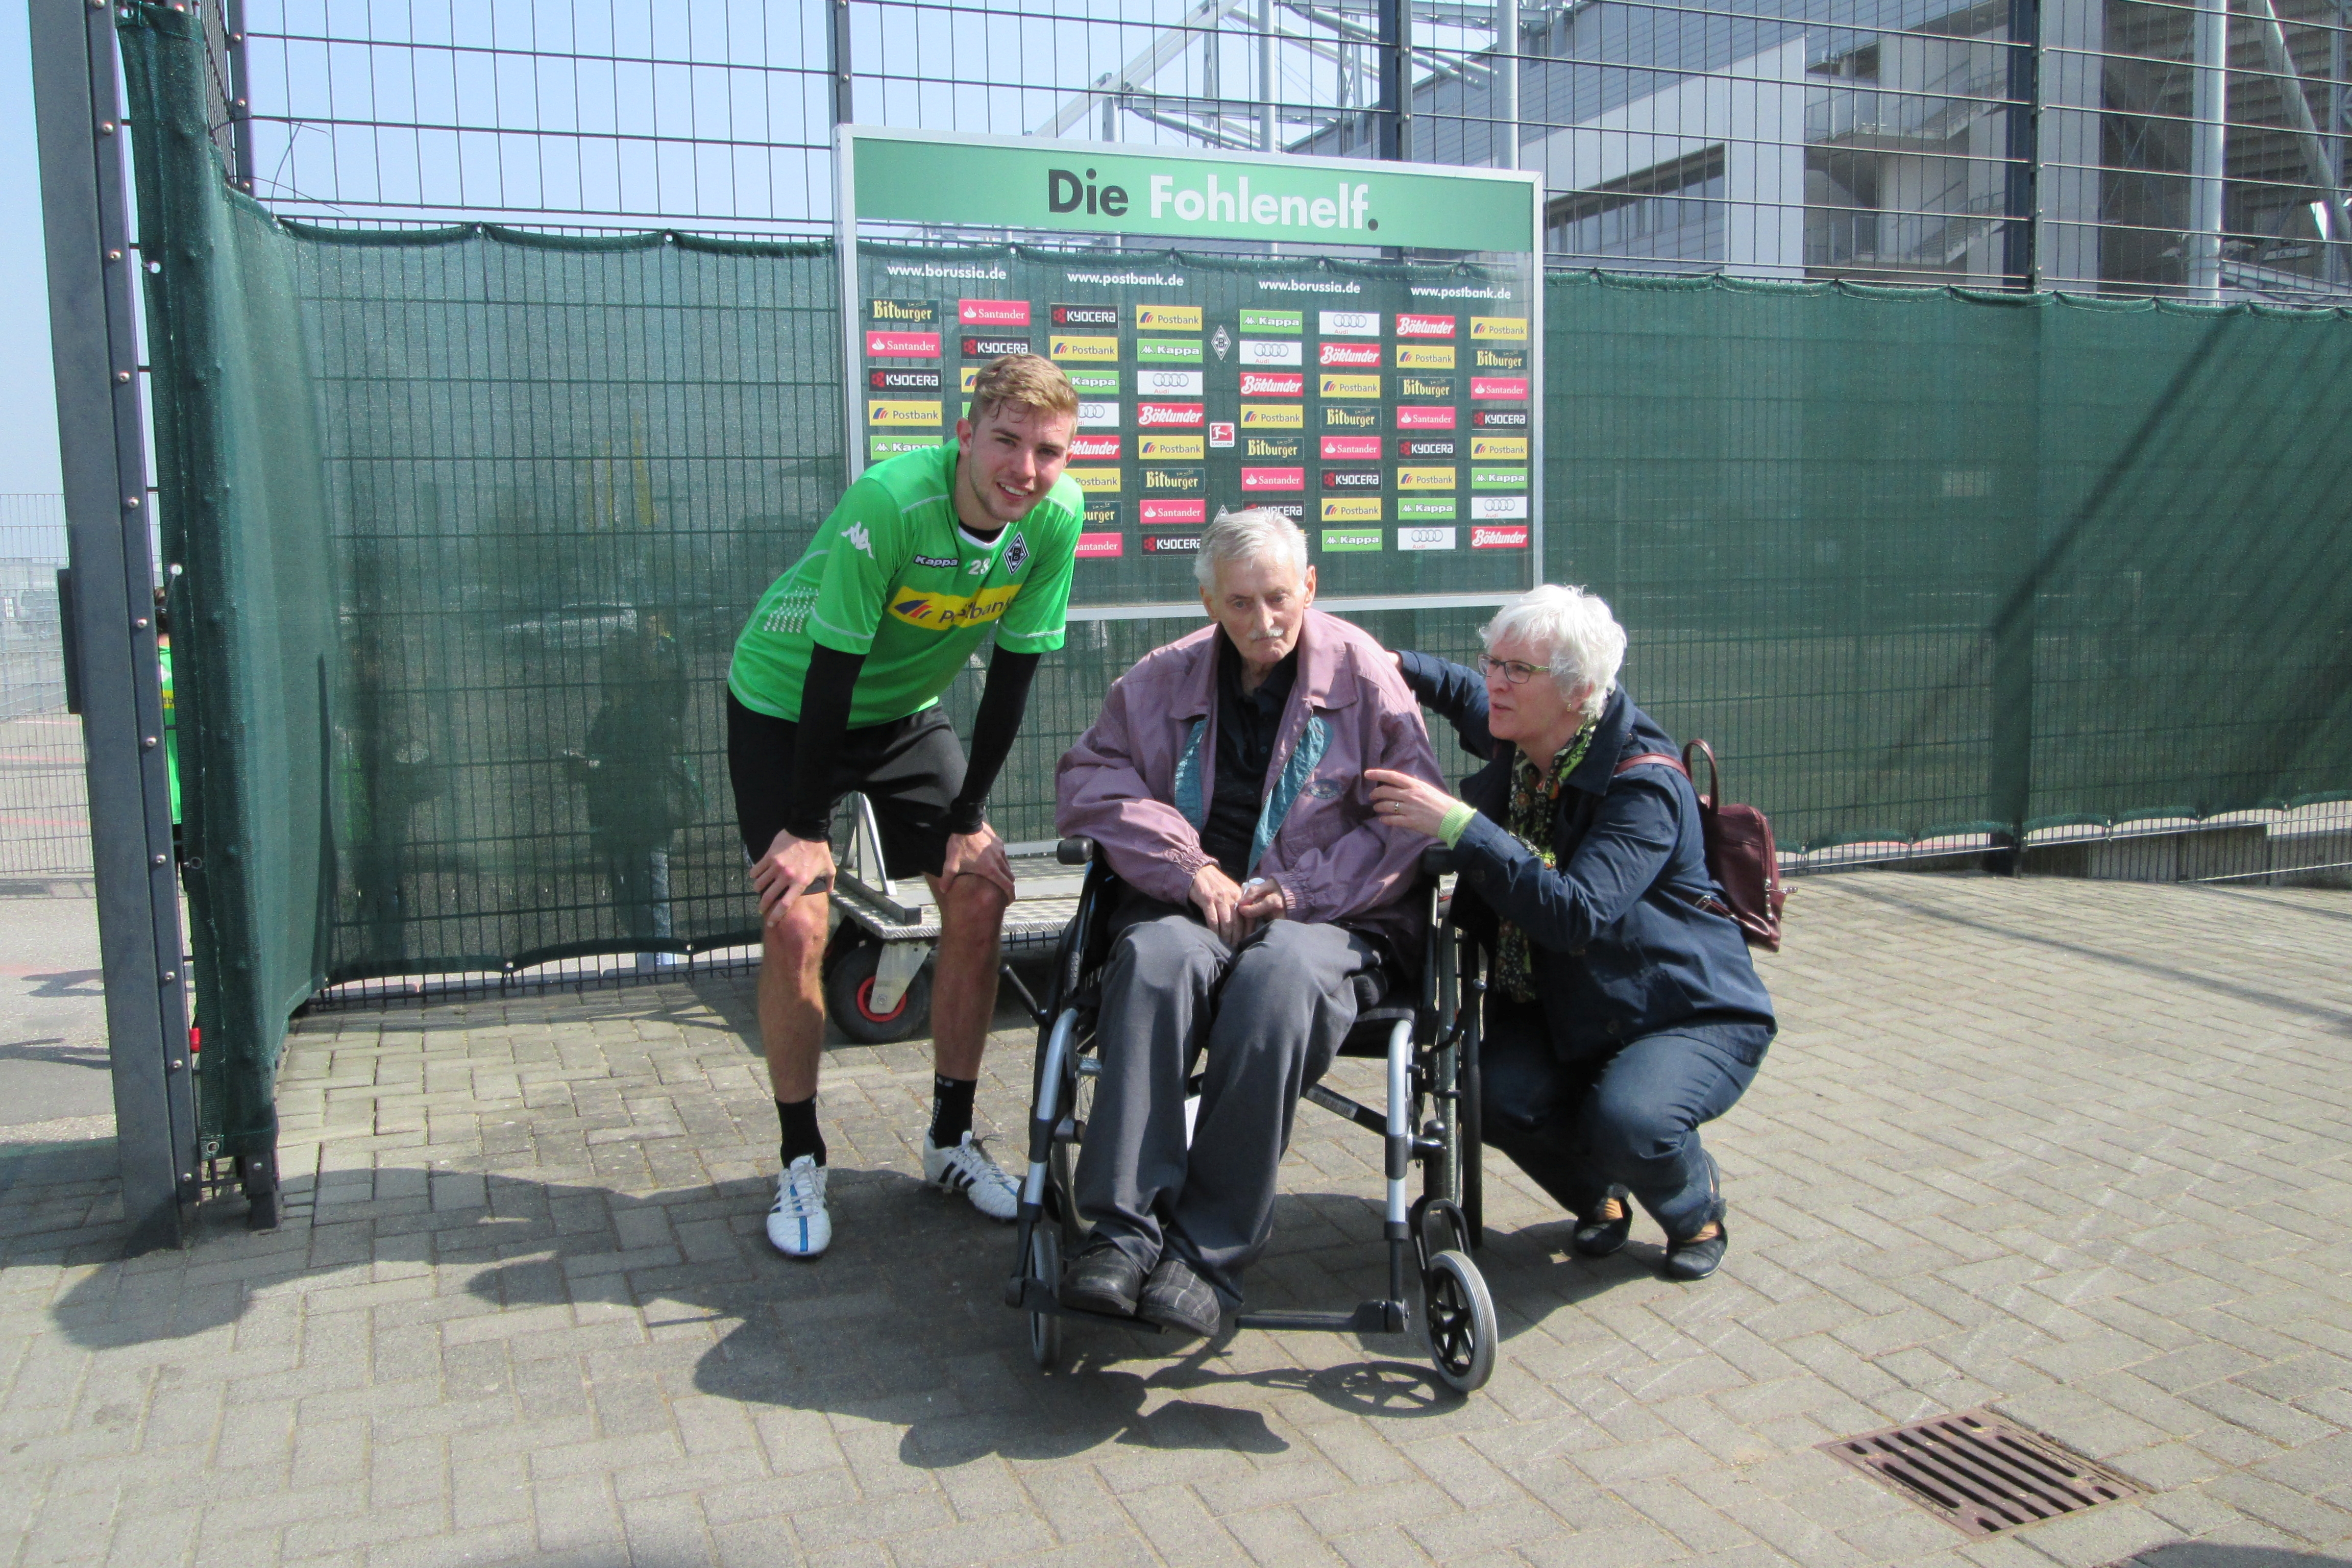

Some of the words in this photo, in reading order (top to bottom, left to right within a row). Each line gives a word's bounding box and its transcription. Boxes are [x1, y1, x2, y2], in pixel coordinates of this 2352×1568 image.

[1049, 168, 1129, 216] Die
[1150, 175, 1379, 231] Fohlenelf.
[887, 264, 1007, 279] www.borussia.de
[1067, 273, 1184, 286] www.postbank.de
[1258, 279, 1361, 294] www.borussia.de
[1410, 286, 1511, 299] www.postbank.de
[873, 300, 932, 322] Bitburger
[978, 308, 1025, 319] Santander
[1158, 315, 1199, 325] Postbank
[1258, 316, 1300, 327] Kappa
[1396, 317, 1454, 335] Böklunder
[1489, 326, 1525, 334] Postbank
[887, 340, 936, 351] Santander
[1072, 346, 1115, 355] Postbank
[1157, 345, 1200, 356] Kappa
[1320, 346, 1380, 364] Böklunder
[1415, 354, 1452, 363] Postbank
[1476, 350, 1522, 369] Bitburger
[1072, 376, 1116, 387] Kappa
[1241, 376, 1302, 395] Böklunder
[1340, 383, 1377, 392] Postbank
[1403, 379, 1450, 398] Bitburger
[1486, 385, 1524, 395] Santander
[893, 410, 938, 420] Postbank
[1139, 406, 1203, 425] Böklunder
[1261, 413, 1300, 422] Postbank
[1327, 409, 1375, 428] Bitburger
[1413, 414, 1451, 423] Santander
[1160, 445, 1200, 453] Postbank
[1247, 439, 1297, 458] Bitburger
[1337, 444, 1377, 453] Santander
[1489, 446, 1525, 454] Postbank
[1075, 477, 1117, 486] Postbank
[1146, 471, 1198, 490] Bitburger
[1258, 476, 1300, 484] Santander
[1416, 475, 1453, 484] Postbank
[1488, 474, 1525, 483] Kappa
[1158, 508, 1201, 518] Santander
[1341, 506, 1379, 515] Postbank
[1415, 504, 1453, 513] Kappa
[1340, 535, 1380, 545] Kappa
[1472, 529, 1527, 547] Böklunder
[915, 555, 959, 568] Kappa
